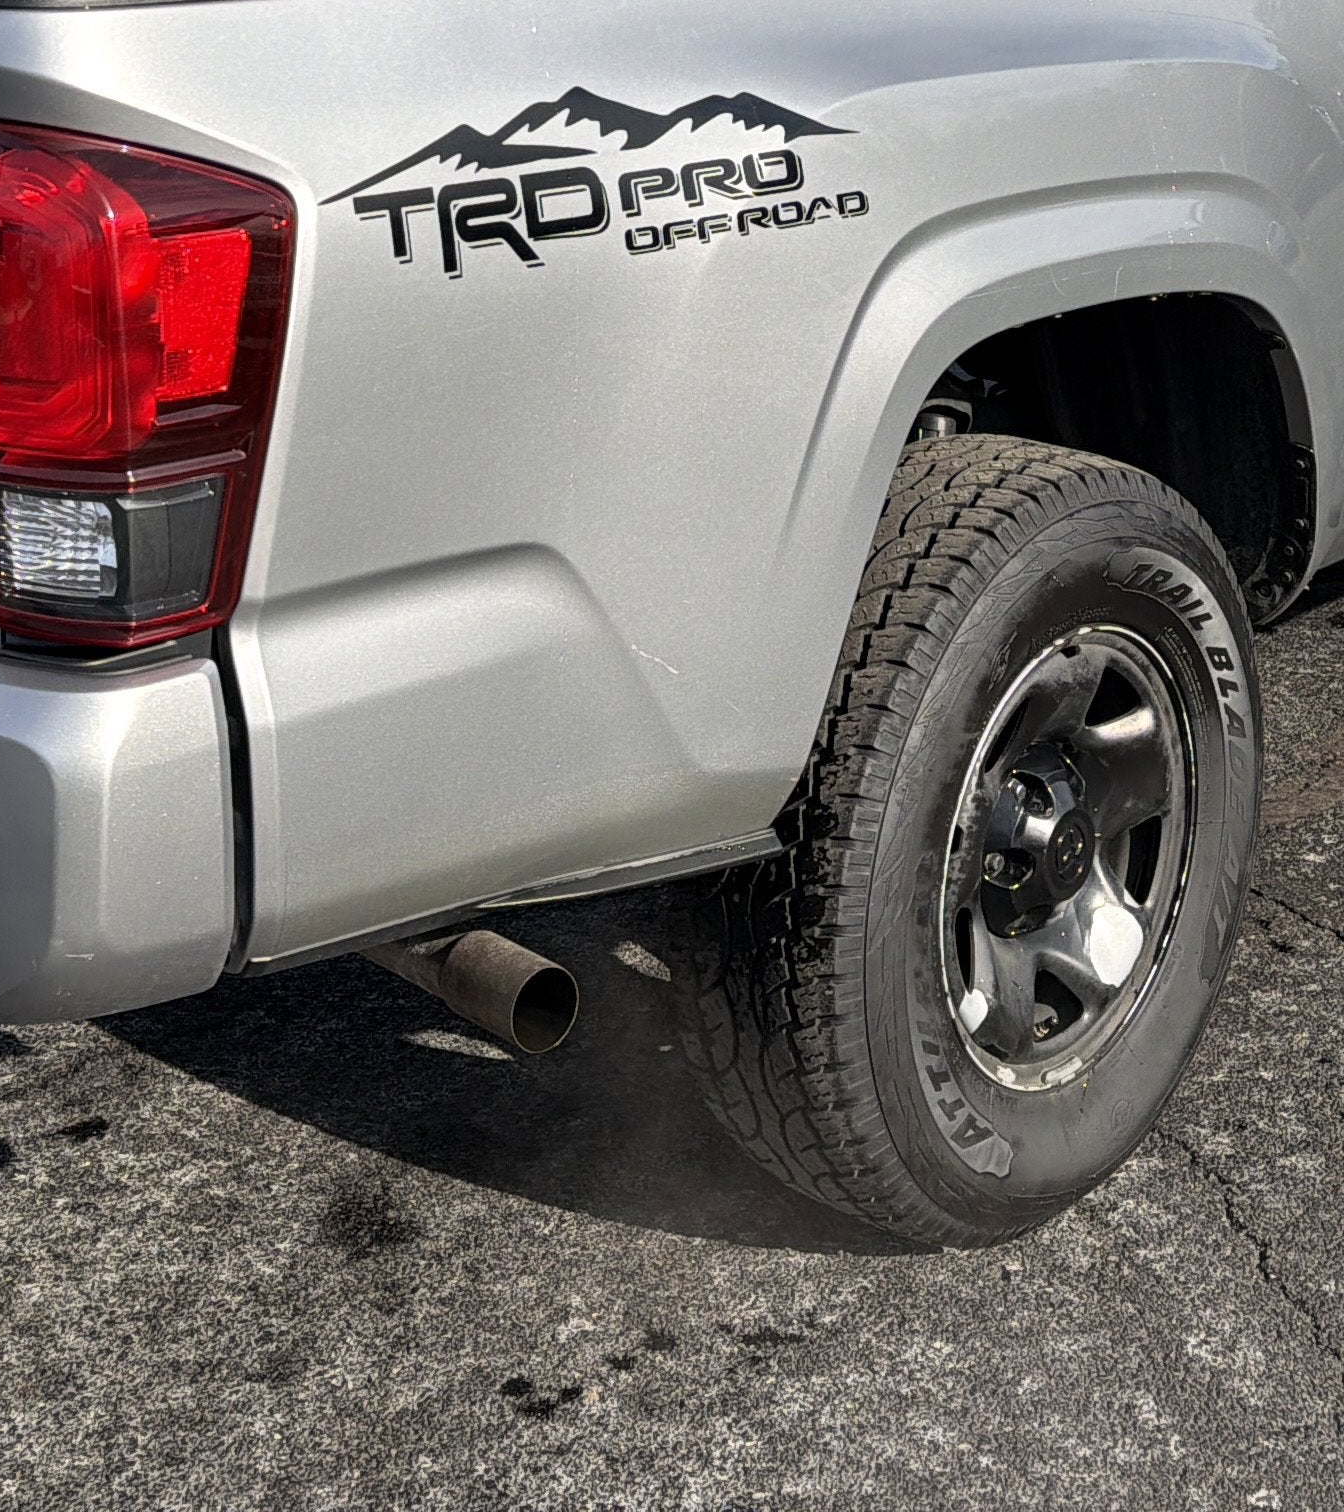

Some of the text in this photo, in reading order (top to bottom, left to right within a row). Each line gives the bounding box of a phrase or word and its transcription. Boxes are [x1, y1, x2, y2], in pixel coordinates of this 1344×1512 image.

[353, 149, 804, 280] TRD PRO
[624, 190, 869, 255] OFF ROAD
[1122, 561, 1214, 632] TRAIL
[1205, 645, 1250, 825] BLADE
